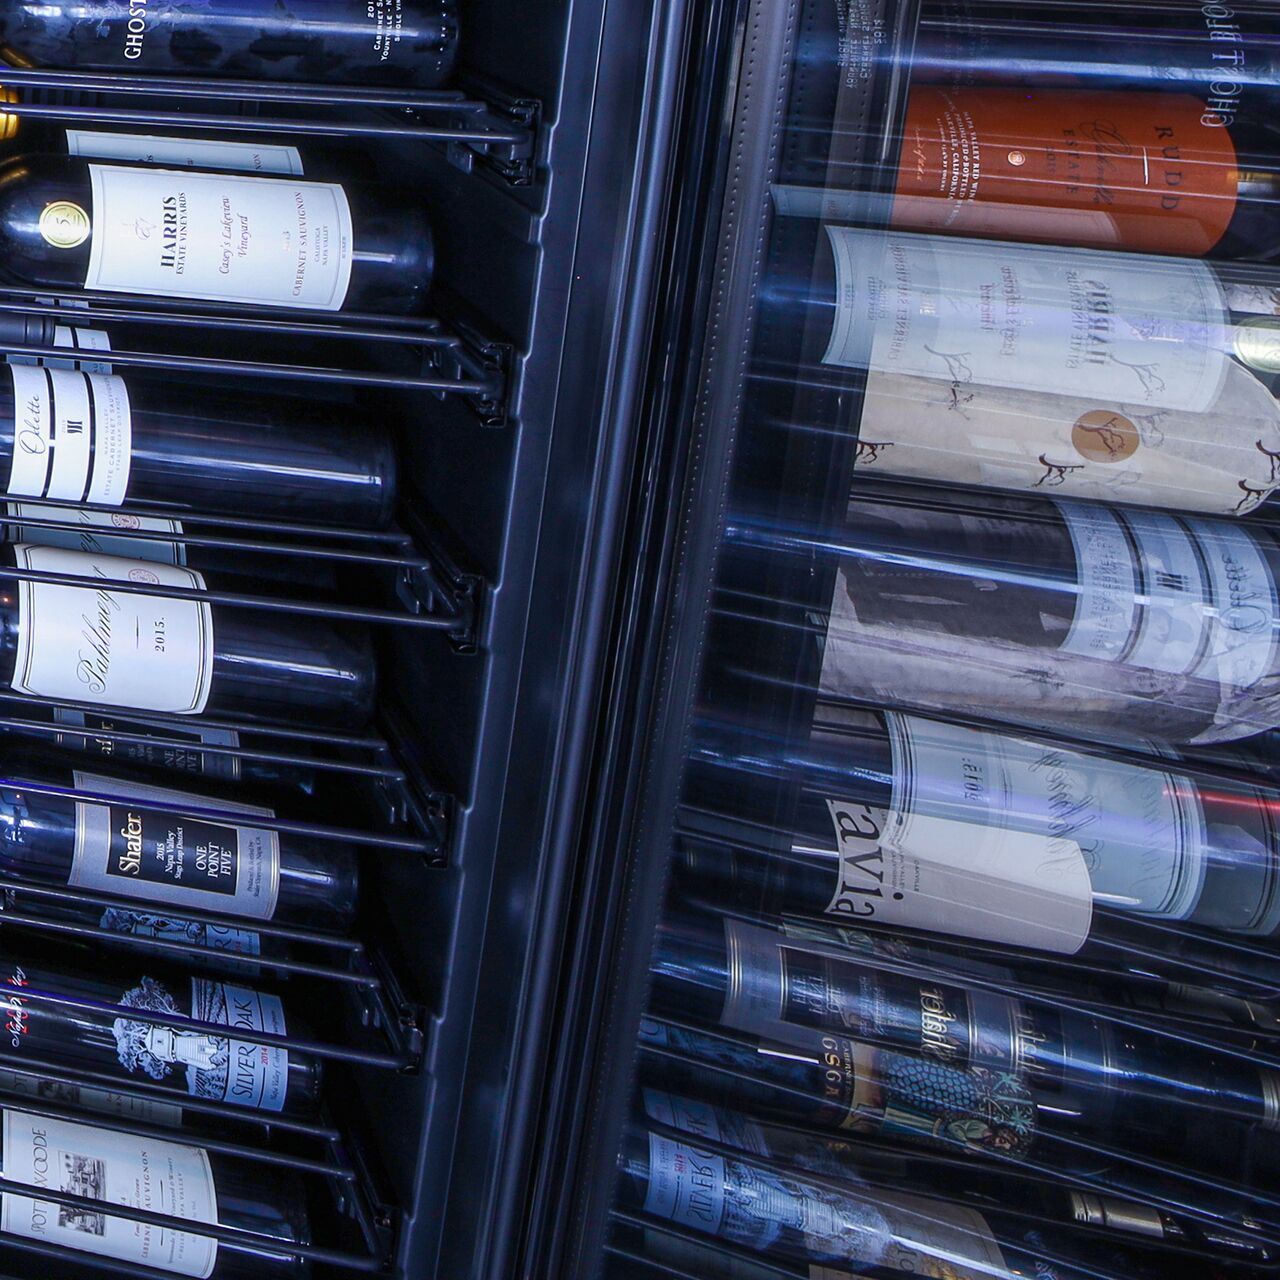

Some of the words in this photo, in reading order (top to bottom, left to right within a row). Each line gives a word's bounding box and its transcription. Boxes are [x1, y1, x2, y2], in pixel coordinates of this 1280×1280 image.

[373, 10, 384, 51] CABERNET
[380, 14, 393, 61] YOUNTVILLE
[394, 13, 402, 43] SINGLE
[969, 131, 981, 161] VALLEY
[947, 152, 960, 201] CALIFORNIA
[972, 162, 980, 180] RED
[1152, 125, 1186, 211] RUDD
[160, 195, 177, 268] HARRIS
[175, 191, 188, 243] VINEYARDS
[218, 196, 235, 240] Lakeview
[293, 190, 309, 247] SAUVIGNON
[236, 215, 252, 259] Vineyard
[174, 245, 187, 275] ESTATE
[217, 241, 236, 275] Casey's
[291, 249, 308, 297] CABERNET
[17, 395, 47, 456] Odette
[117, 812, 143, 876] Shafer
[156, 842, 166, 862] 2015
[165, 830, 178, 853] Valley
[175, 827, 185, 850] District
[164, 854, 176, 874] Napa
[173, 866, 184, 880] Stags
[175, 850, 185, 866] Leap
[194, 845, 208, 871] ONE
[207, 841, 220, 878] POINT
[220, 848, 233, 876] FIVE
[231, 1045, 258, 1100] SILVER
[260, 1047, 270, 1066] 2014
